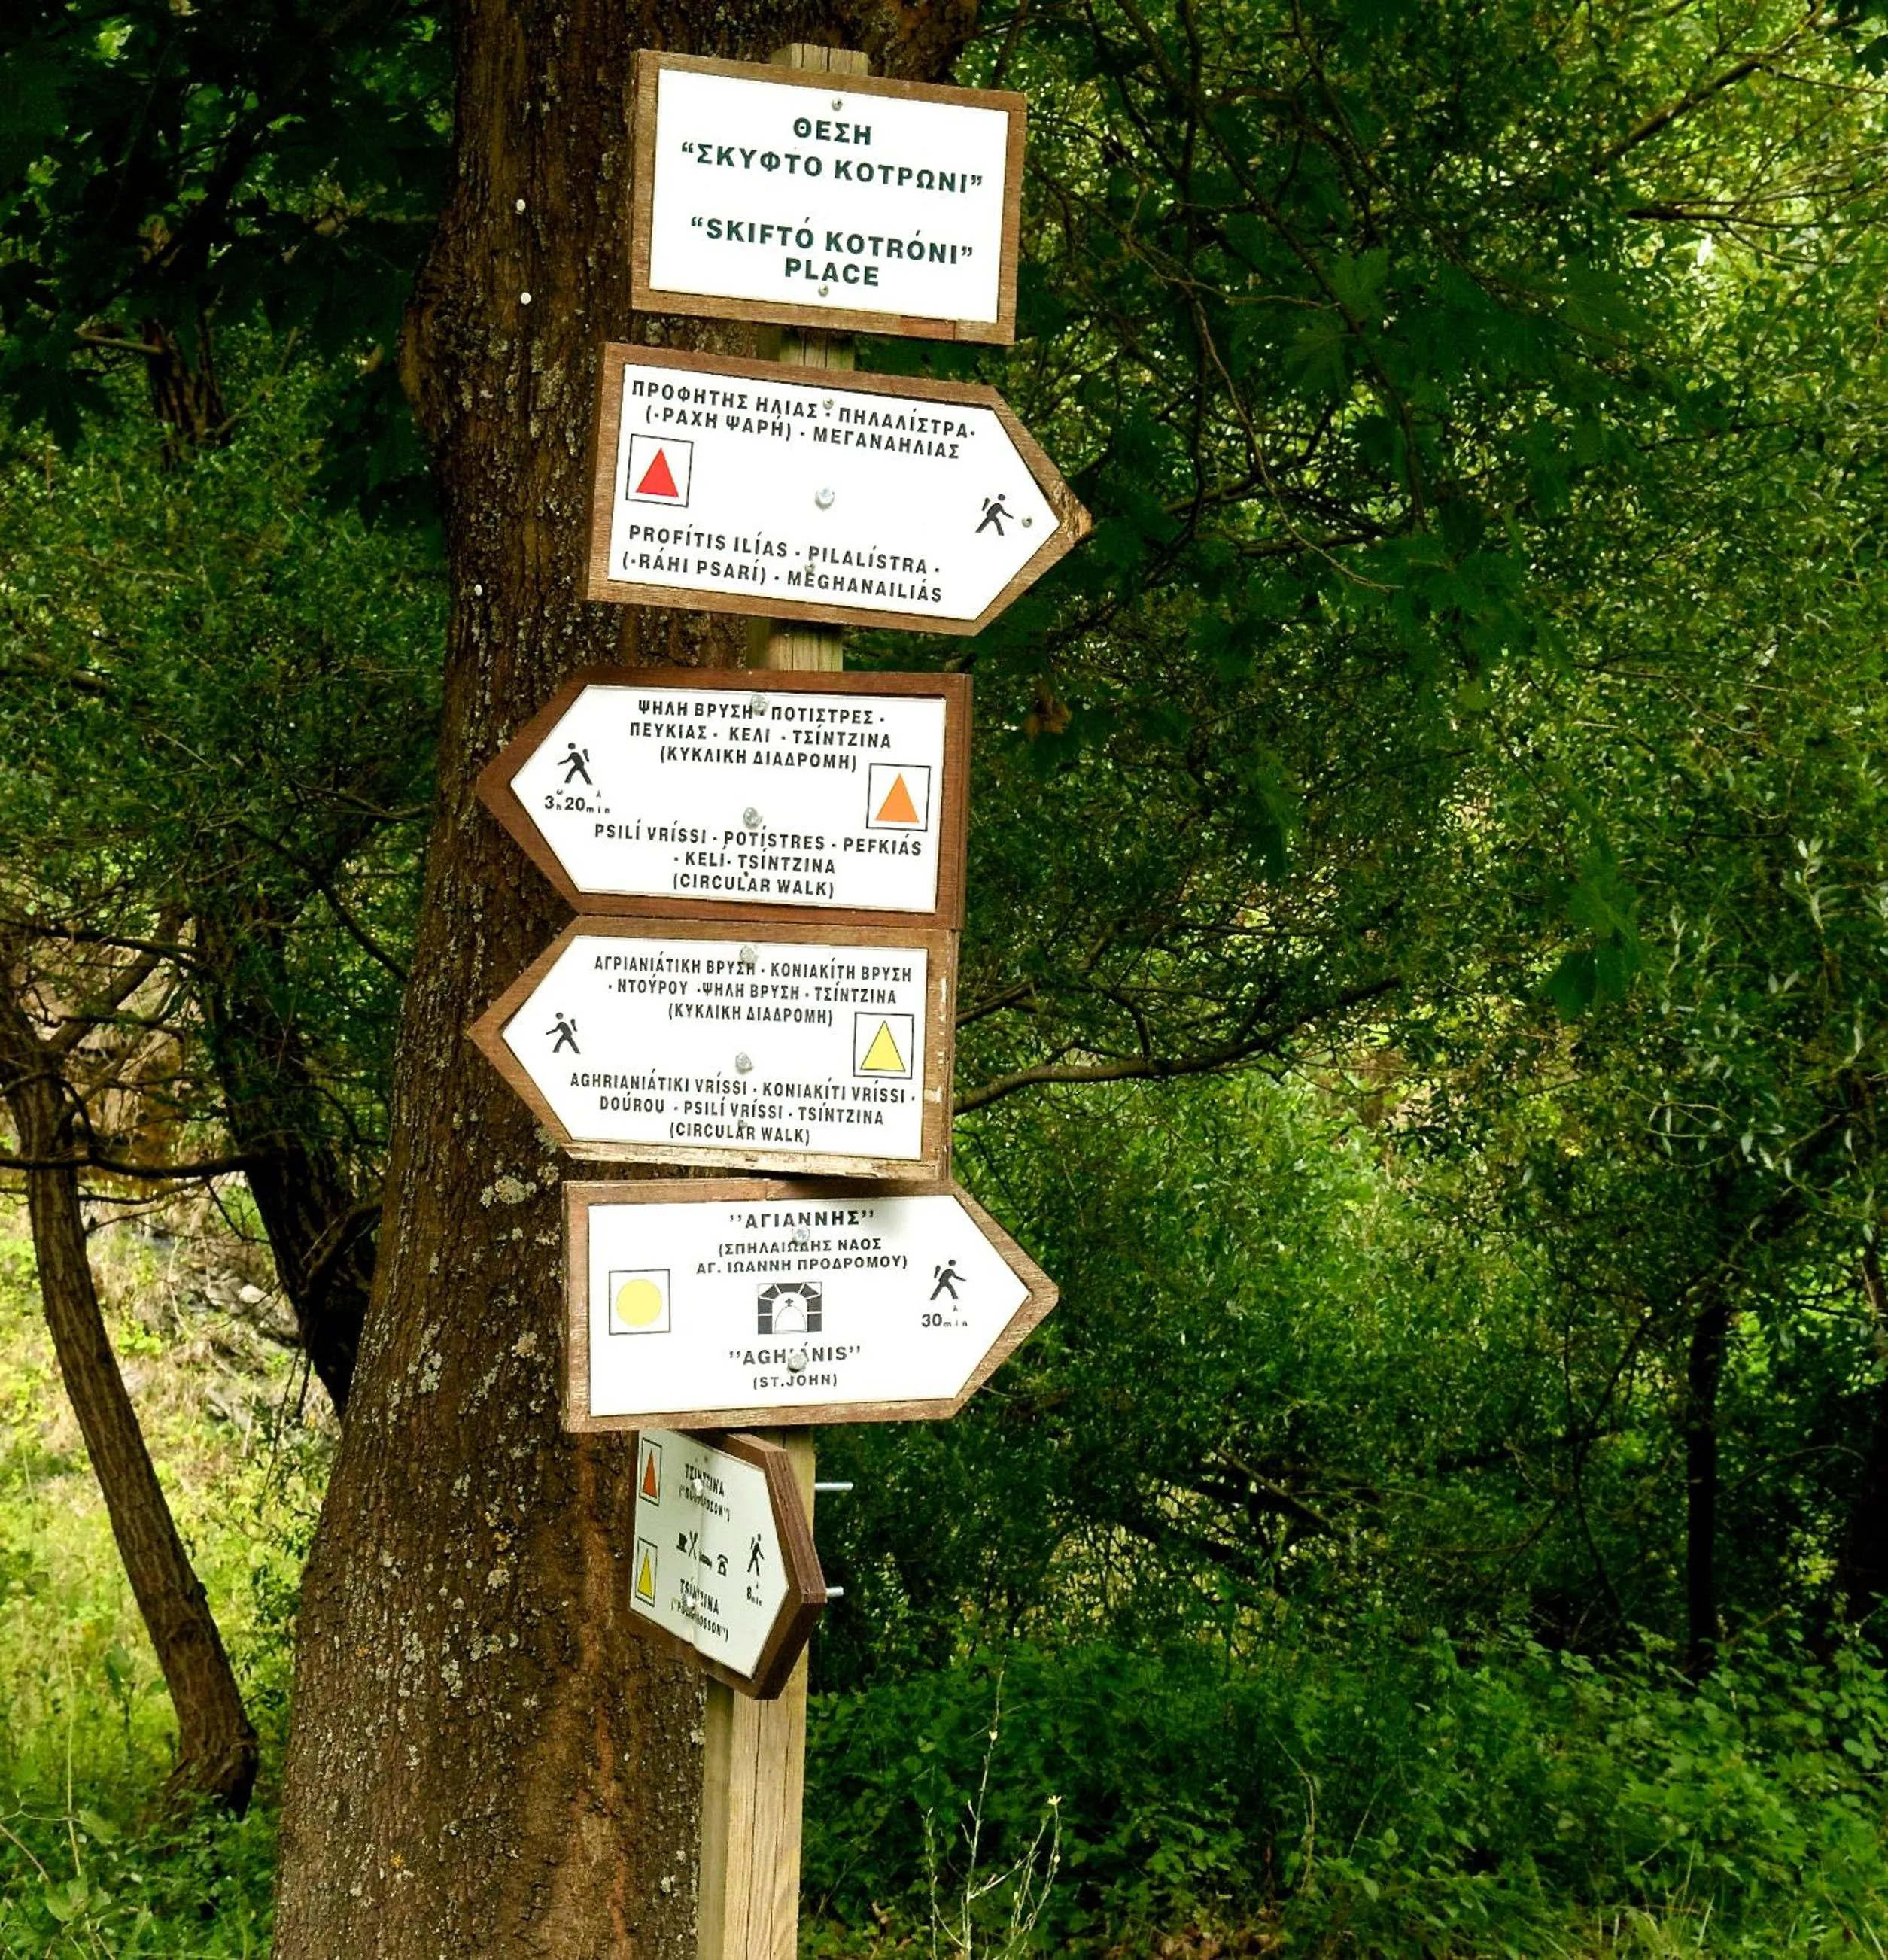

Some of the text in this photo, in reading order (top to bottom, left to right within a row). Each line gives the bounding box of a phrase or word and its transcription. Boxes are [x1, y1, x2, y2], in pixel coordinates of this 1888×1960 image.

[793, 117, 872, 146] ΘΕΣΗ
[681, 141, 982, 193] “ΣΚΥΦΤΟ ΚΟΤΡΩΝΙ”
[691, 217, 973, 264] “SKIFTÓ KOTRÓNI”
[785, 258, 879, 287] PLACE
[632, 380, 748, 409] ΠΡΟΦΗΤΗΣ
[756, 397, 818, 418] ΗΛΙΑΣ
[813, 427, 959, 459] ΜΕΓΑΝΑΗΛΙΑΣ
[629, 524, 927, 574] PROFÍTIS ILÍAS PILALÍSTRA
[696, 559, 766, 586] PSARÍ)
[638, 700, 873, 725] ΨΗΛΗ ΒΡΥΣΗ ΠΟΤΙΣΤΡΕΣ
[630, 722, 891, 749] ΠΕΥΚΙΑΣ ΚΕΛΙ ΤΣΊΝΤΖΙΝΑ
[660, 746, 856, 773] (ΚΥΚΛΙΚΗ ΔΙΑΔΡΟΜΗ)
[595, 819, 922, 856] PSILÍ VRÍSSI POTÍSTRES PEFKIÁS
[737, 847, 836, 874] TSÍNTZINA
[673, 873, 834, 899] (CIRCULAR WALK)
[594, 951, 911, 982] ΑΓΡΙΑΝΙΆΤΙΚΗ ΒΡΥΣΗ ΚΟΝΙΑΚΊΤΗ ΒΡΥΣΗ
[618, 973, 688, 995] ΝΤΟΎΡΟΥ
[750, 984, 799, 1000] ΒΡΥΣΗ
[815, 981, 896, 1004] ΤΣΊΝΤΖΙΝΑ
[668, 1003, 832, 1026] (ΚΥΚΛΙΚΗ ΔΙΑΔΡΟΜΗ)
[570, 1068, 905, 1103] AGHRIANIÁTIKI VRÍSSI KONIAKÍTI VRÍSSI
[600, 1091, 883, 1125] DOÚROU PSILÍ VRÍSSI TSÍNTZINA
[670, 1122, 810, 1146] (CIRCULAR WALK)
[838, 1238, 882, 1251] ΝΑΟΣ
[696, 1255, 908, 1275] ΑΓ. ΙΩΑΝΝΗ ΠΡΟΔΡΟΜΟΥ)
[753, 1374, 837, 1390] (ST.JOHN)
